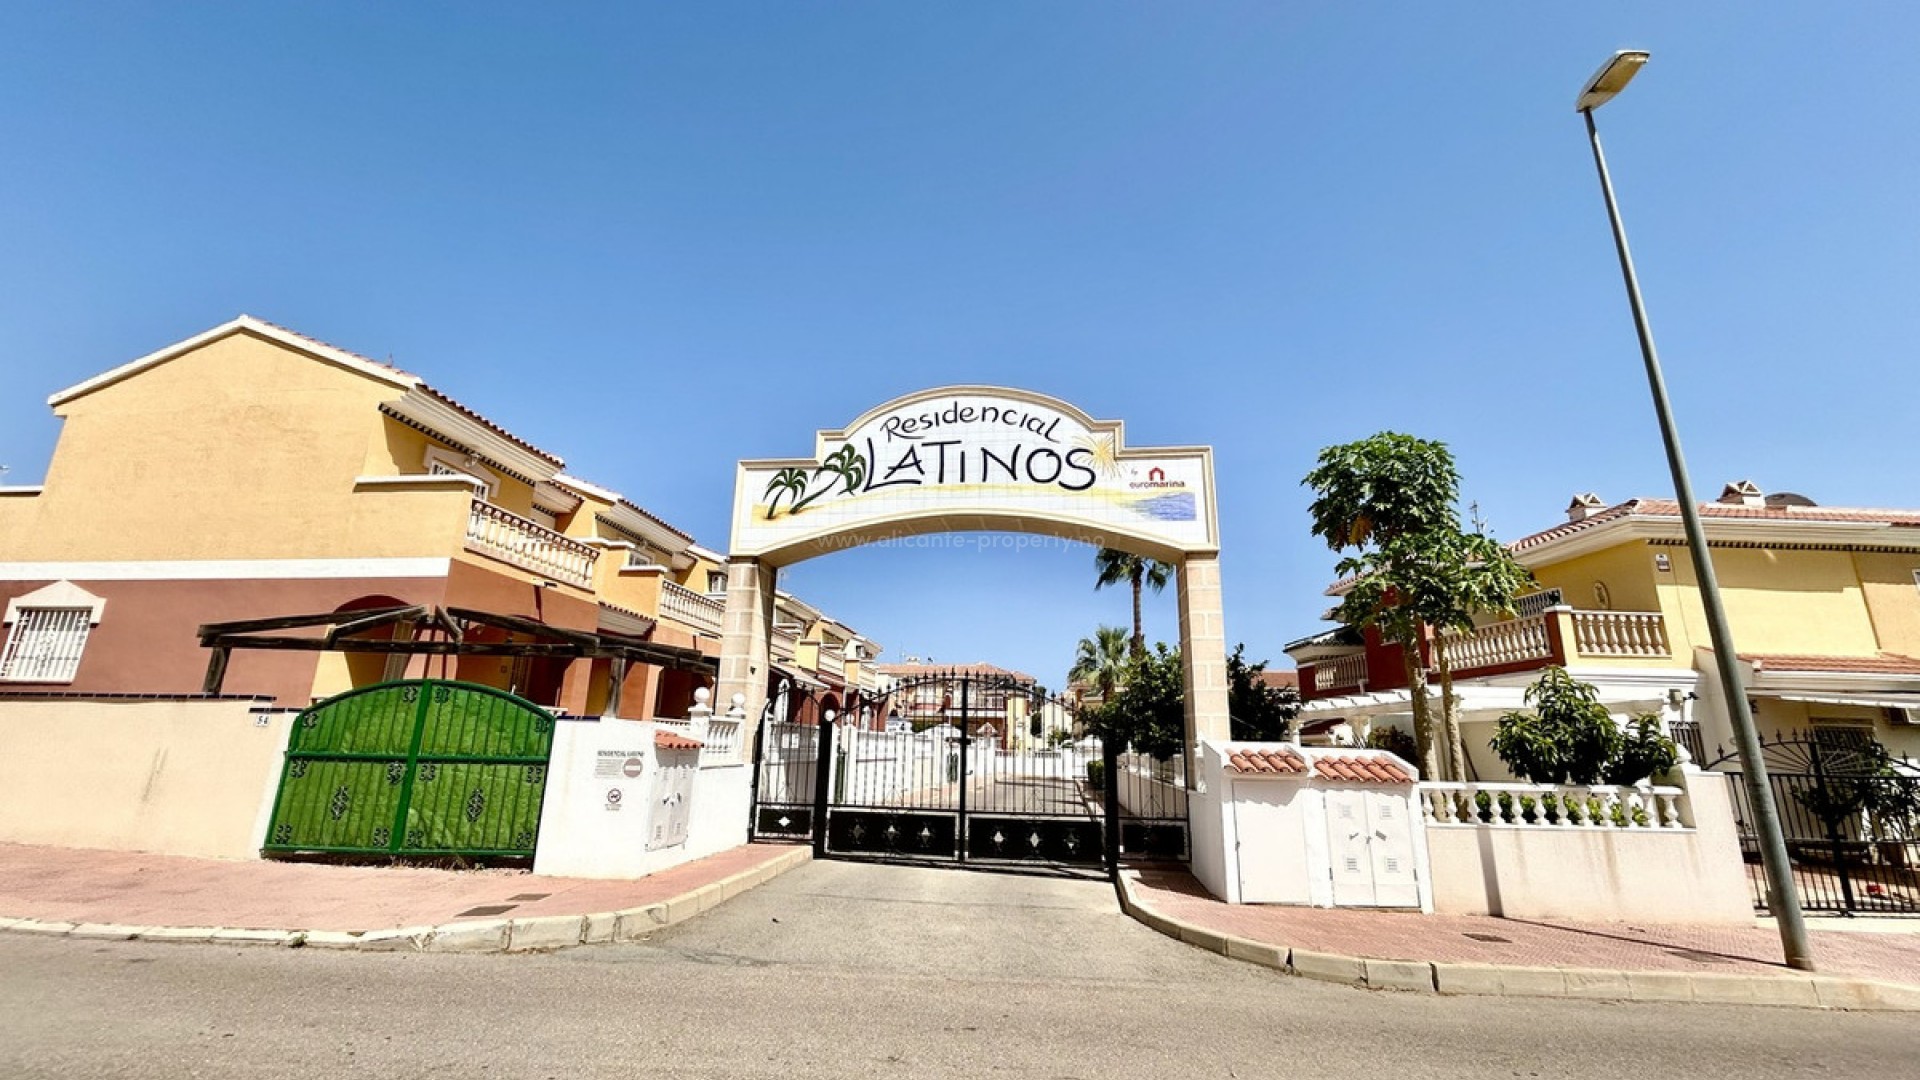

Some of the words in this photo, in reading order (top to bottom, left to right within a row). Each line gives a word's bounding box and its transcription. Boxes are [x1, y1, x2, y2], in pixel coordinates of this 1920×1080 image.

[880, 401, 1061, 443] Residencial
[862, 436, 1097, 493] LATINOS
[1129, 480, 1185, 489] euromarina
